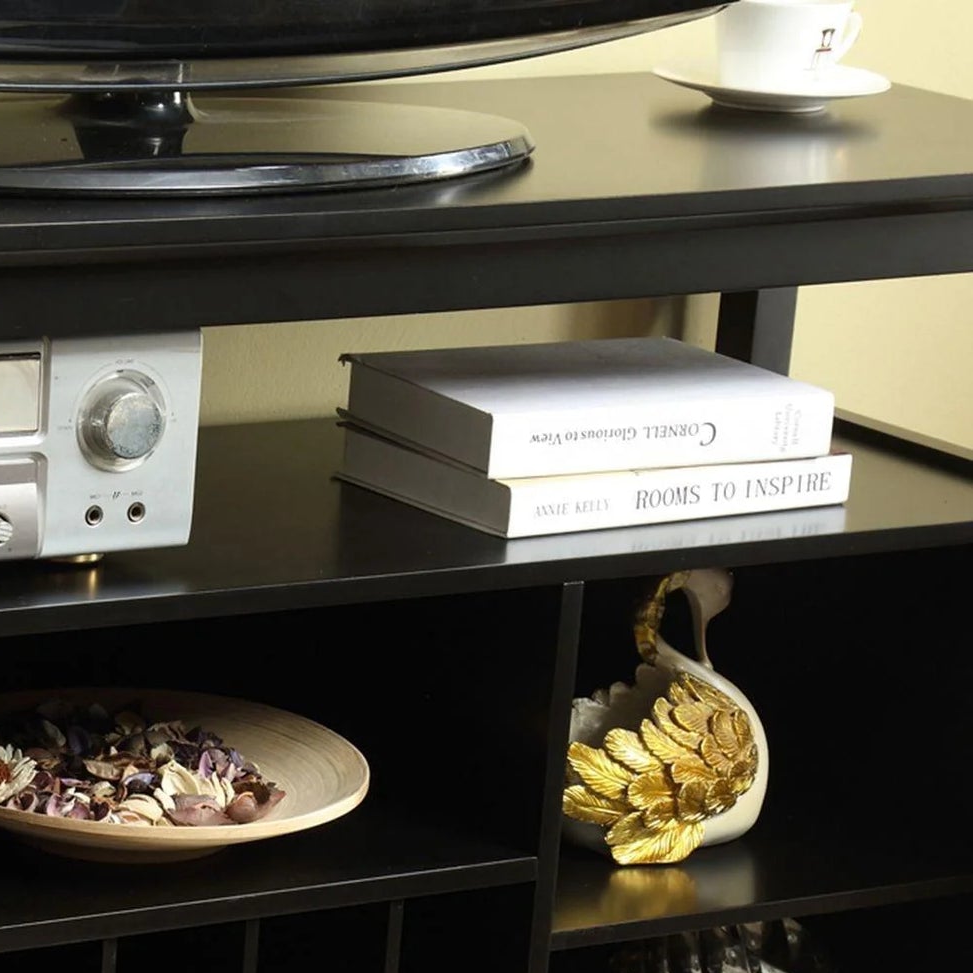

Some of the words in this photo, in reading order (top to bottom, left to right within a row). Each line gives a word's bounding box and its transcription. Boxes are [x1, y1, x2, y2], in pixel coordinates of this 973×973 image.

[530, 430, 563, 446] View
[565, 430, 579, 442] to
[581, 426, 637, 443] Glorious
[534, 501, 570, 518] ANNIE
[575, 498, 611, 515] KELLY
[635, 484, 701, 510] ROOMS
[711, 481, 737, 502] TO
[745, 471, 832, 499] INSPIRE
